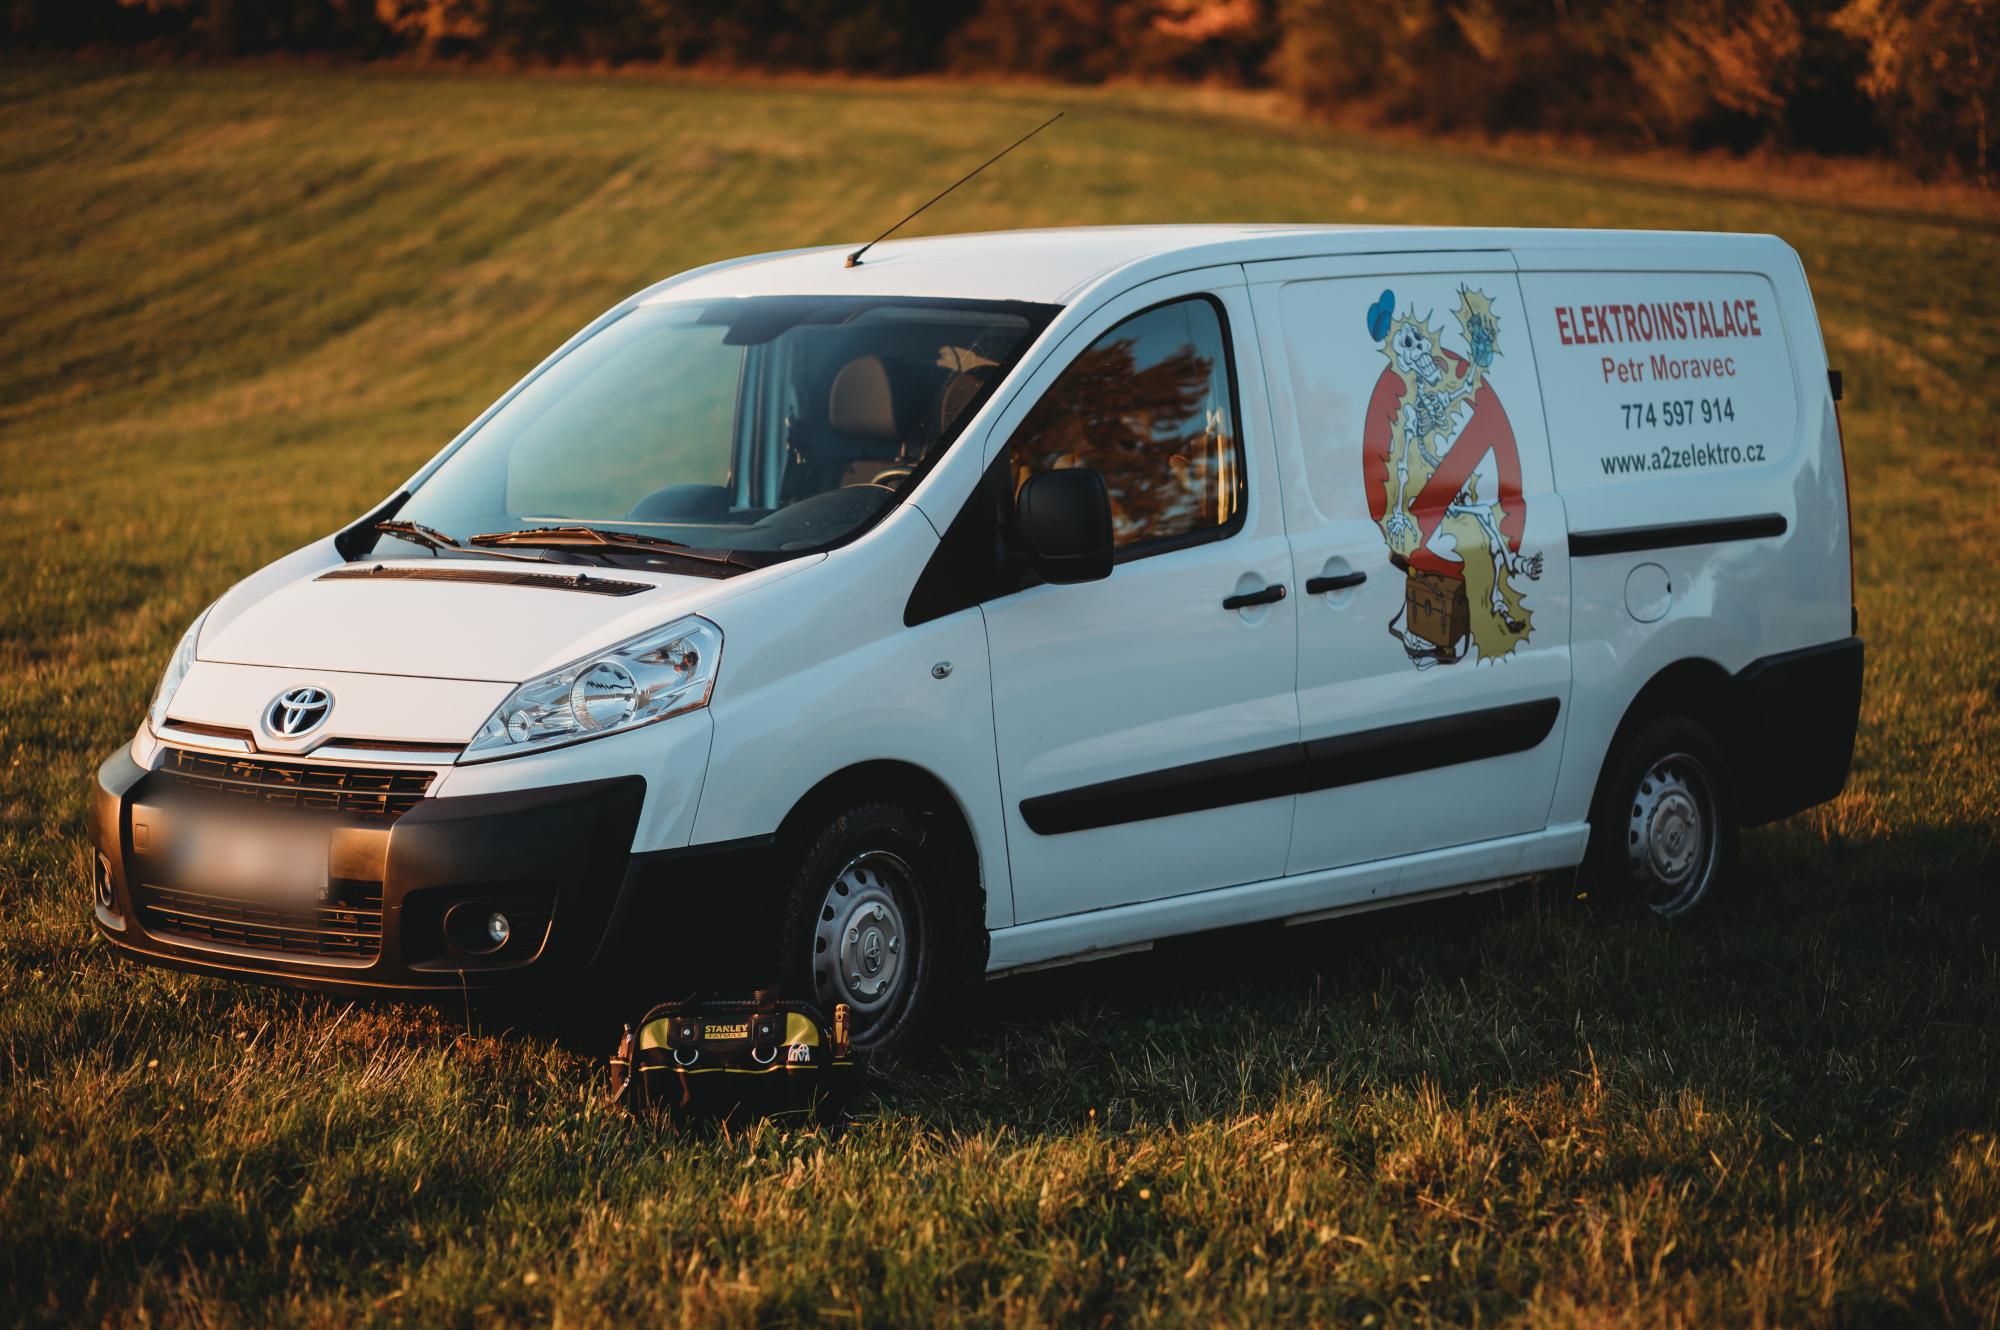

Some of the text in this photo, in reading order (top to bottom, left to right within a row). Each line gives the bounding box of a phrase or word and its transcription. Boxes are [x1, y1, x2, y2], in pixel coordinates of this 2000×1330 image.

[1555, 299, 1762, 345] ELEKTROINSTALACE
[1601, 354, 1736, 384] Petr Moravec
[1621, 397, 1735, 430] 774 597 914
[1601, 443, 1766, 475] www.a2zelektro.cz
[704, 1024, 748, 1033] STANLEY
